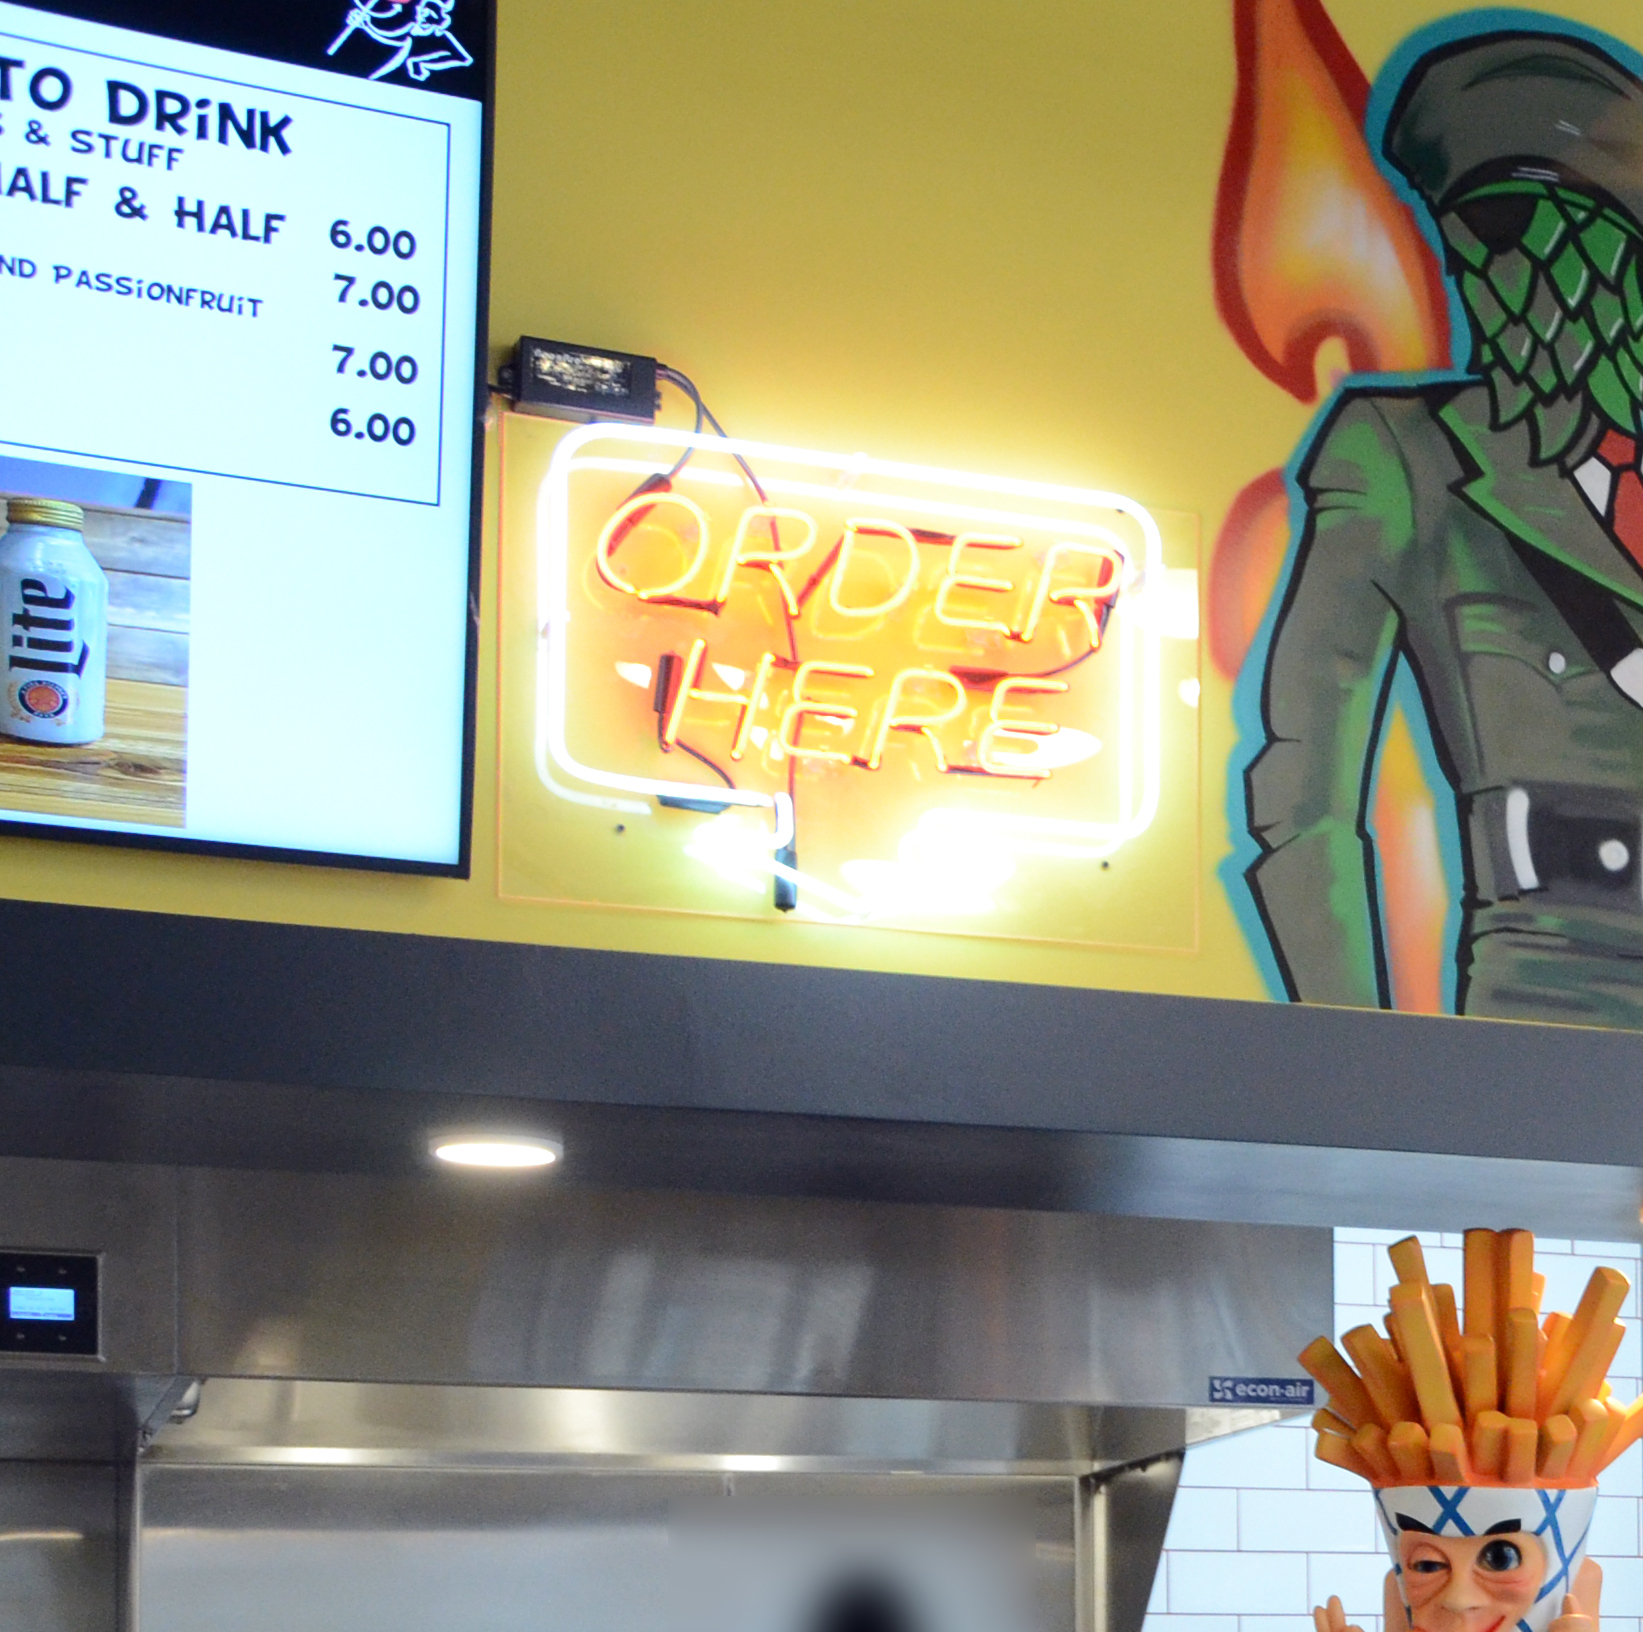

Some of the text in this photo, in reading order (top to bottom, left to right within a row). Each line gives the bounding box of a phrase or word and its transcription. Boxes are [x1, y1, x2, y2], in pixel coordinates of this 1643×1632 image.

[0, 56, 73, 113] TO
[24, 119, 51, 147] &
[70, 129, 184, 170] STUFF
[0, 160, 417, 260] ALF & HALF 6.00
[333, 274, 420, 315] 7.00
[331, 344, 419, 385] 7.00
[329, 407, 417, 447] 6.00
[596, 492, 1124, 650] ORDER
[8, 577, 91, 679] Lite
[661, 636, 1070, 780] HERE
[1234, 1381, 1311, 1398] econ-air
